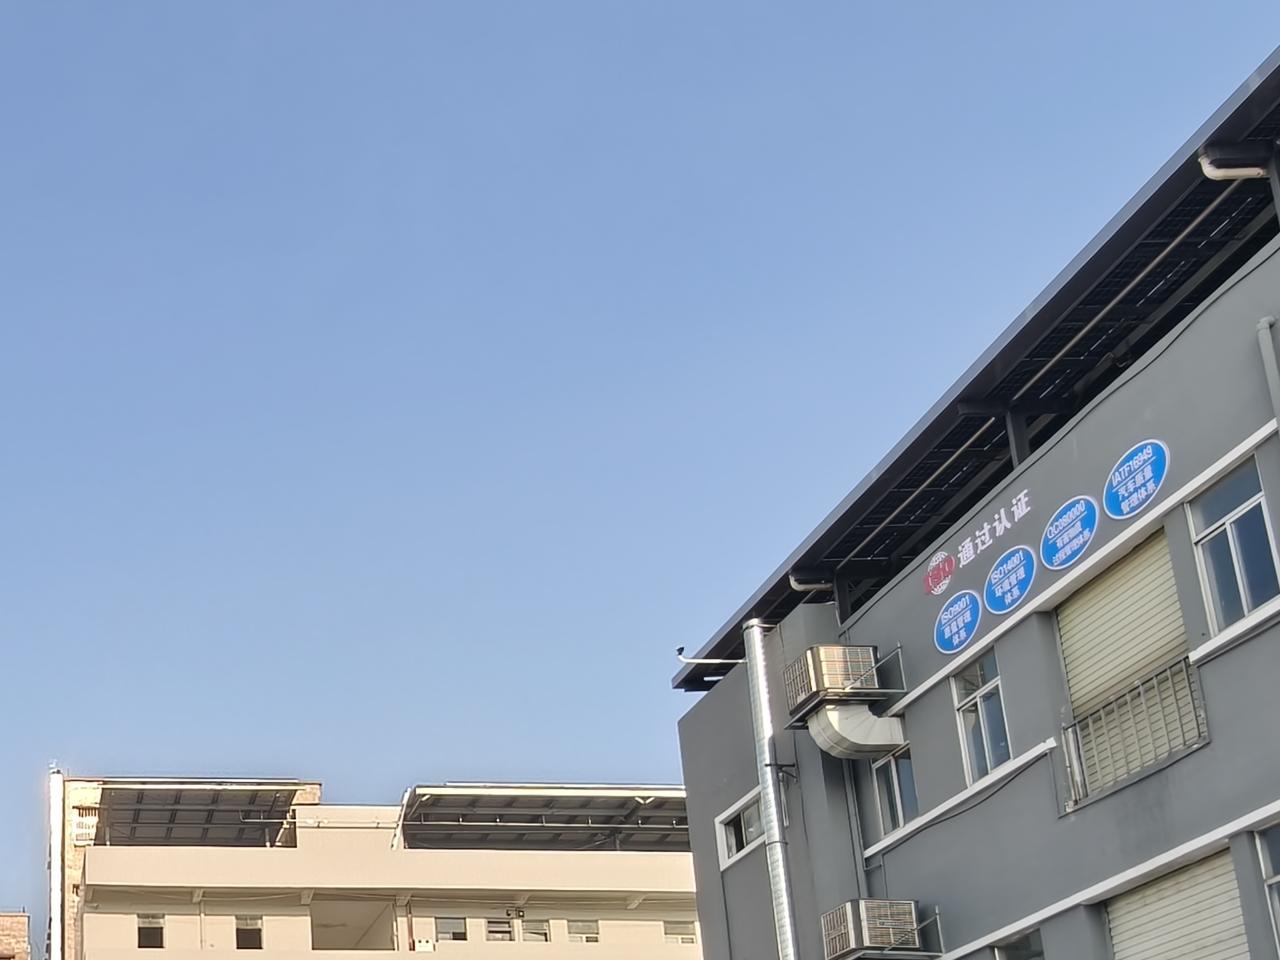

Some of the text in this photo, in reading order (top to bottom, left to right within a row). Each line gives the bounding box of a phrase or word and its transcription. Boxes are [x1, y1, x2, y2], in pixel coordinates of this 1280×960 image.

[958, 489, 1031, 568] 通过认证
[941, 594, 970, 625] ISO9001
